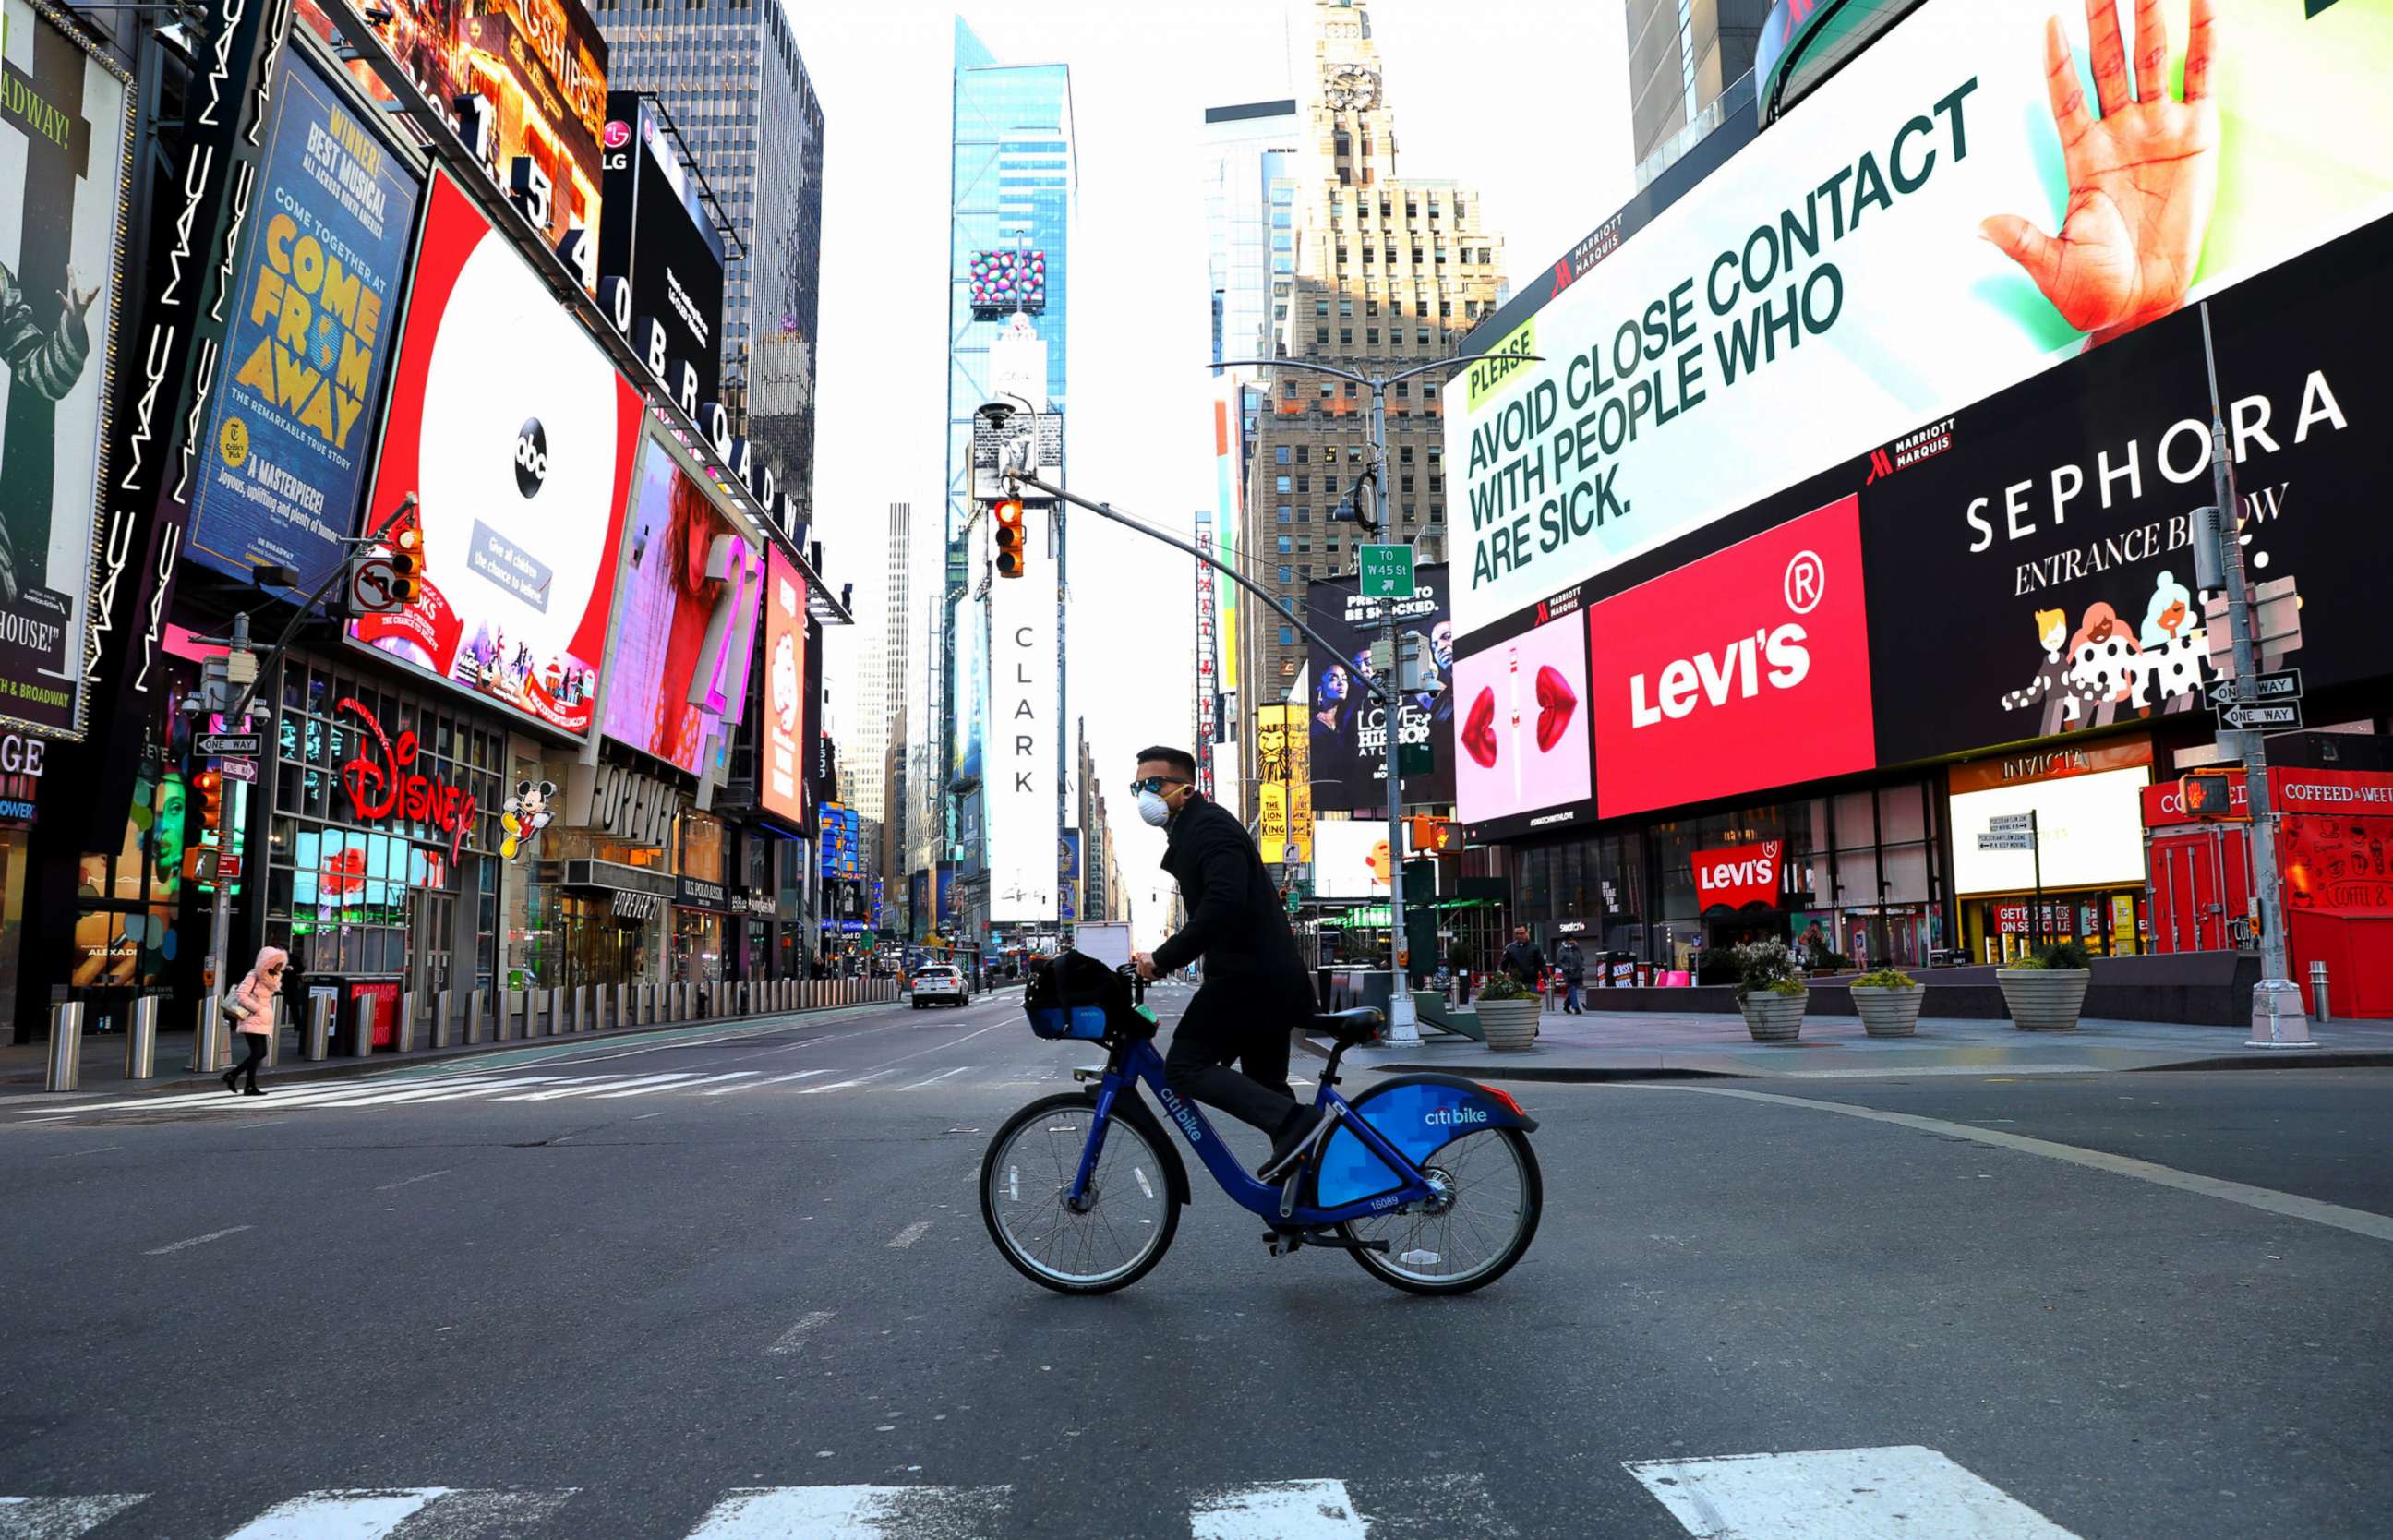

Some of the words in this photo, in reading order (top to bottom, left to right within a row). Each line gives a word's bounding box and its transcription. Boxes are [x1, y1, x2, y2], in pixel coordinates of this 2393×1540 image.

[330, 103, 381, 178] WINNER!
[303, 154, 316, 175] ALL
[307, 121, 341, 174] BEST
[339, 153, 386, 223] MUSICAL
[602, 154, 627, 170] LG
[275, 186, 312, 228] COME
[315, 220, 370, 283] TOGETHER
[372, 277, 387, 294] AT
[1575, 212, 1623, 259] MARRIOTT
[1575, 233, 1618, 279] MARQUIS
[267, 213, 382, 348] COME
[1468, 379, 1557, 479] AVOID
[1566, 278, 1697, 410] CLOSE
[1706, 77, 1978, 316] CONTACT
[1471, 330, 1532, 399] PLEASE
[235, 335, 363, 450] AWAY
[1468, 444, 1545, 531] WITH
[1555, 344, 1706, 485] PEOPLE
[1714, 262, 1844, 387] WHO
[232, 388, 248, 406] THE
[250, 397, 307, 441] REMARKABLE
[307, 434, 327, 455] TRUE
[328, 445, 353, 471] STORY
[1895, 418, 1955, 453] MARRIOTT
[229, 451, 241, 460] Pick
[514, 436, 547, 481] abc
[1896, 435, 1950, 468] MARQUIS
[1966, 370, 2348, 553] SEPHORA
[218, 466, 246, 498] Joyous,
[247, 485, 278, 514] uplifting
[277, 499, 290, 517] and
[290, 505, 312, 532] plenty
[258, 460, 324, 515] MASTERPIECE!
[1473, 514, 1533, 590] ARE
[1540, 463, 1630, 554] SICK.
[475, 550, 487, 568] the
[487, 559, 511, 584] chance
[511, 571, 520, 587] to
[488, 536, 503, 557] Give
[512, 550, 538, 580] children
[1367, 565, 1377, 575] W
[1378, 565, 1393, 575] 45
[1396, 565, 1407, 575] St
[1380, 551, 1393, 561] TO
[2014, 523, 2160, 596] ENTRANCE
[1414, 585, 1433, 599] TO
[1549, 586, 1581, 608] MARRIOTT
[1345, 608, 1363, 621] BE
[1366, 600, 1439, 620] SHCKED.
[1550, 598, 1579, 618] MARQUIS
[10, 681, 18, 696] &
[20, 683, 69, 708] BROADWAY
[2219, 688, 2236, 699] ON
[2258, 680, 2287, 693] WAY
[1015, 627, 1035, 793] CLARK
[2231, 711, 2254, 721] ONE
[2264, 709, 2289, 721] WAY
[206, 740, 224, 749] ONE
[233, 740, 253, 749] WAY
[226, 763, 237, 773] ONE
[241, 766, 252, 776] WAY
[2002, 749, 2088, 780] INVICTA
[2161, 785, 2247, 813] COED
[2285, 784, 2353, 802] COFFEED
[1262, 824, 1284, 837] KING
[1263, 811, 1282, 823] LION
[694, 883, 709, 897] POLO
[611, 891, 648, 918] FOREVER
[2001, 908, 2022, 919] GET
[2002, 922, 2016, 932] ON
[1613, 962, 1633, 977] JERSEY
[1370, 1196, 1399, 1210] 16089
